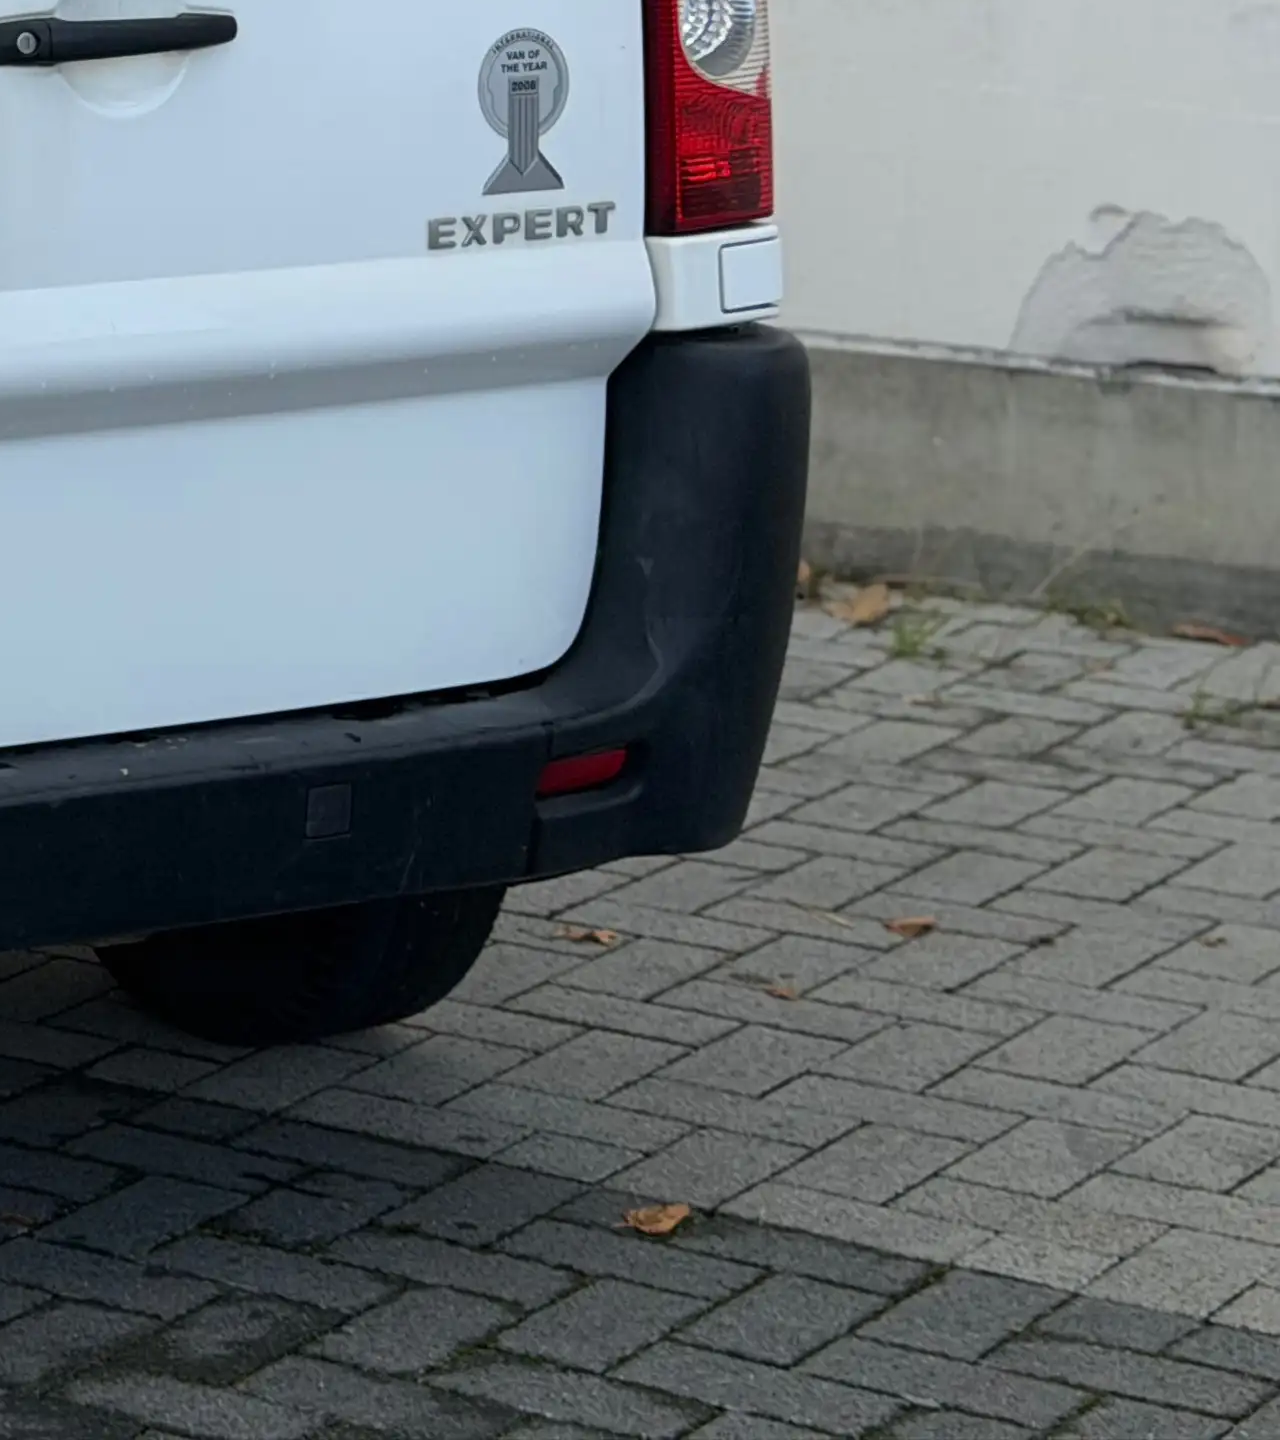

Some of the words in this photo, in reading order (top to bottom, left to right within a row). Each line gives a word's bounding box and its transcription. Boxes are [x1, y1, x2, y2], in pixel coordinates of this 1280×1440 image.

[505, 50, 525, 60] VAN
[528, 49, 540, 59] OF
[500, 63, 520, 73] THE
[522, 61, 547, 72] YEAR
[427, 201, 616, 250] EXPERT
